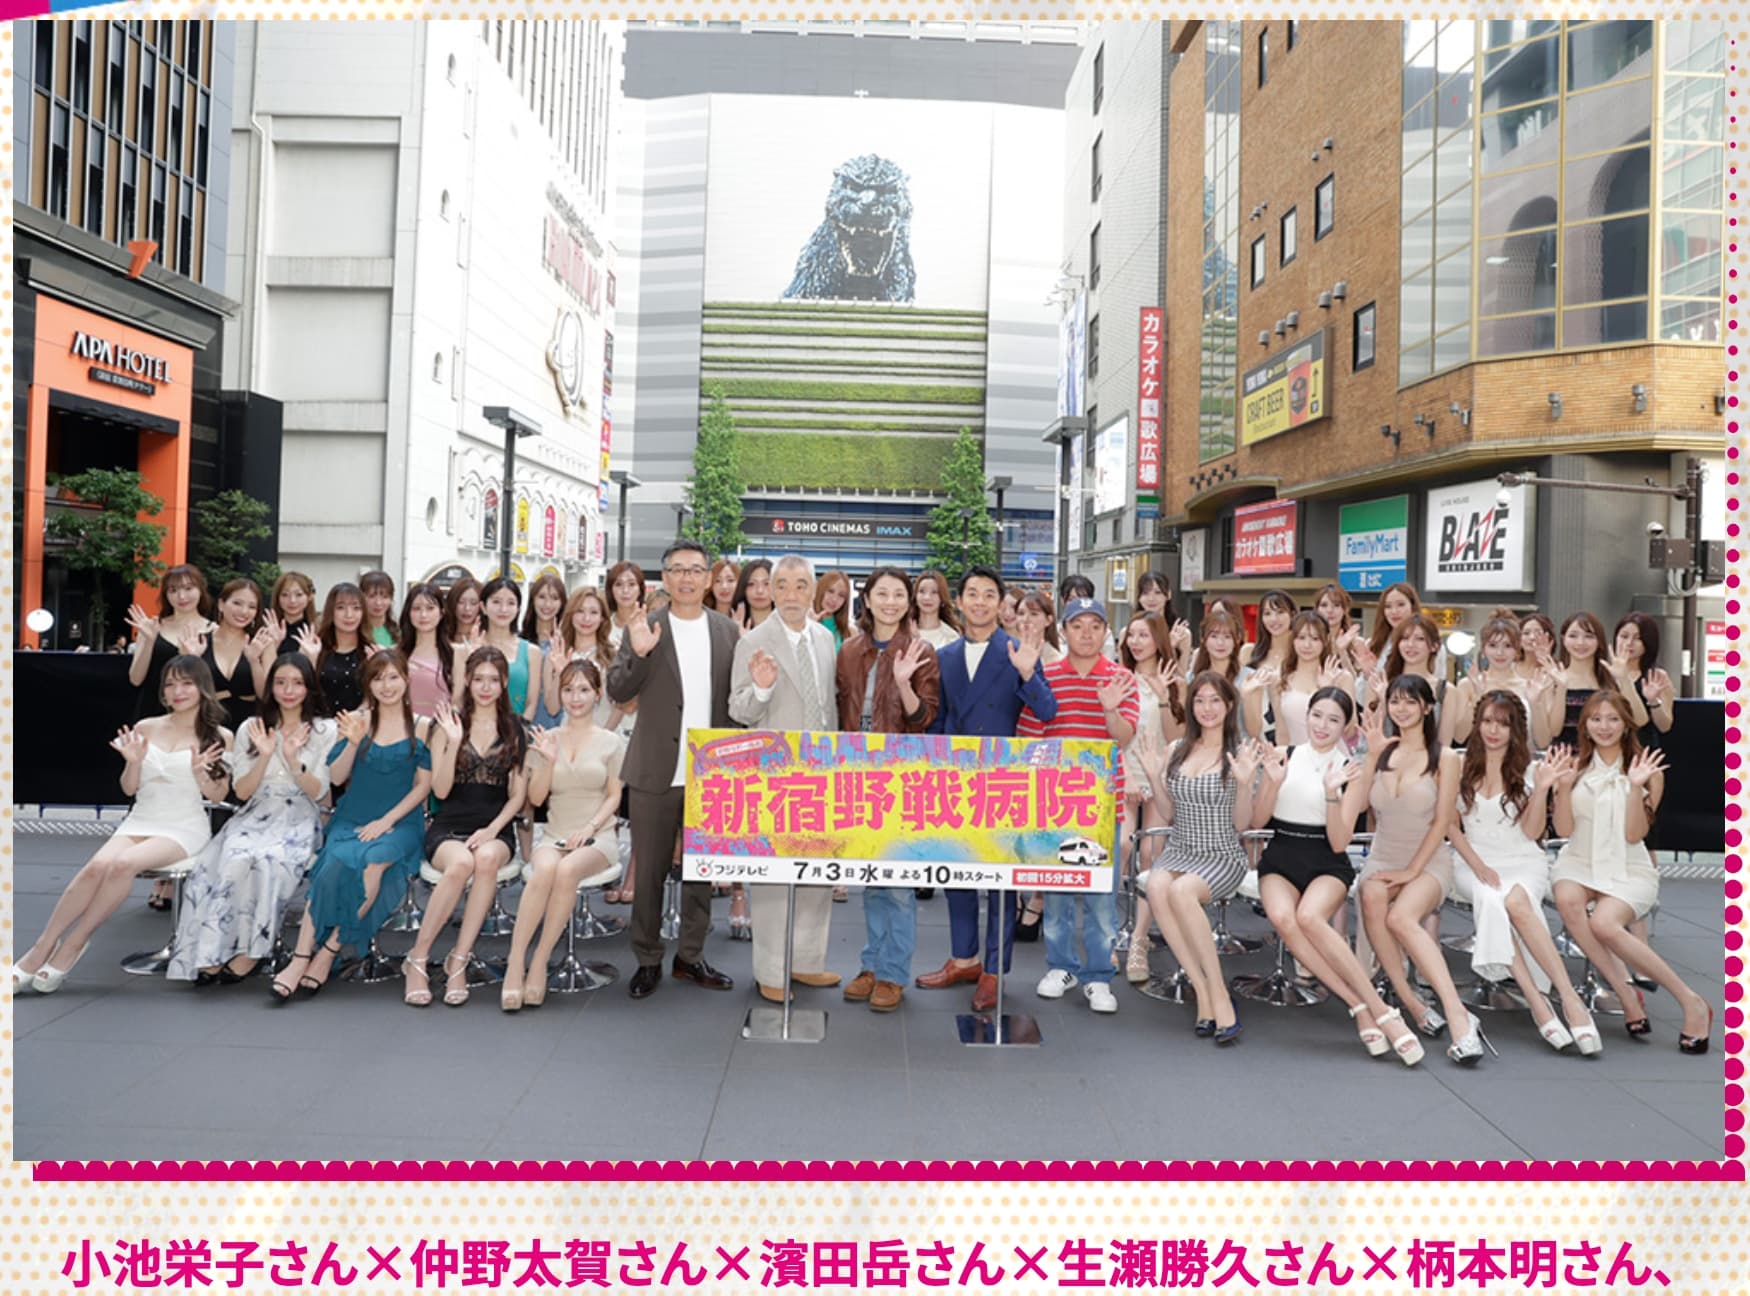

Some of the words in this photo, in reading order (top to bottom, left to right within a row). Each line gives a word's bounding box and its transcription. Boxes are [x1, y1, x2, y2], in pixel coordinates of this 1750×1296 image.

[72, 331, 114, 365] APA
[115, 344, 173, 383] HOTEL
[1142, 313, 1160, 397] カラオケ
[1139, 419, 1159, 484] 歌広場
[787, 521, 818, 533] TOHO
[819, 522, 871, 535] CINEMAS
[876, 525, 913, 536] IMAX
[1346, 533, 1400, 559] FamilyMart
[1438, 505, 1510, 563] BLAZE
[701, 766, 1099, 835] 新宿野戦病院
[714, 864, 769, 877] フジテレビ
